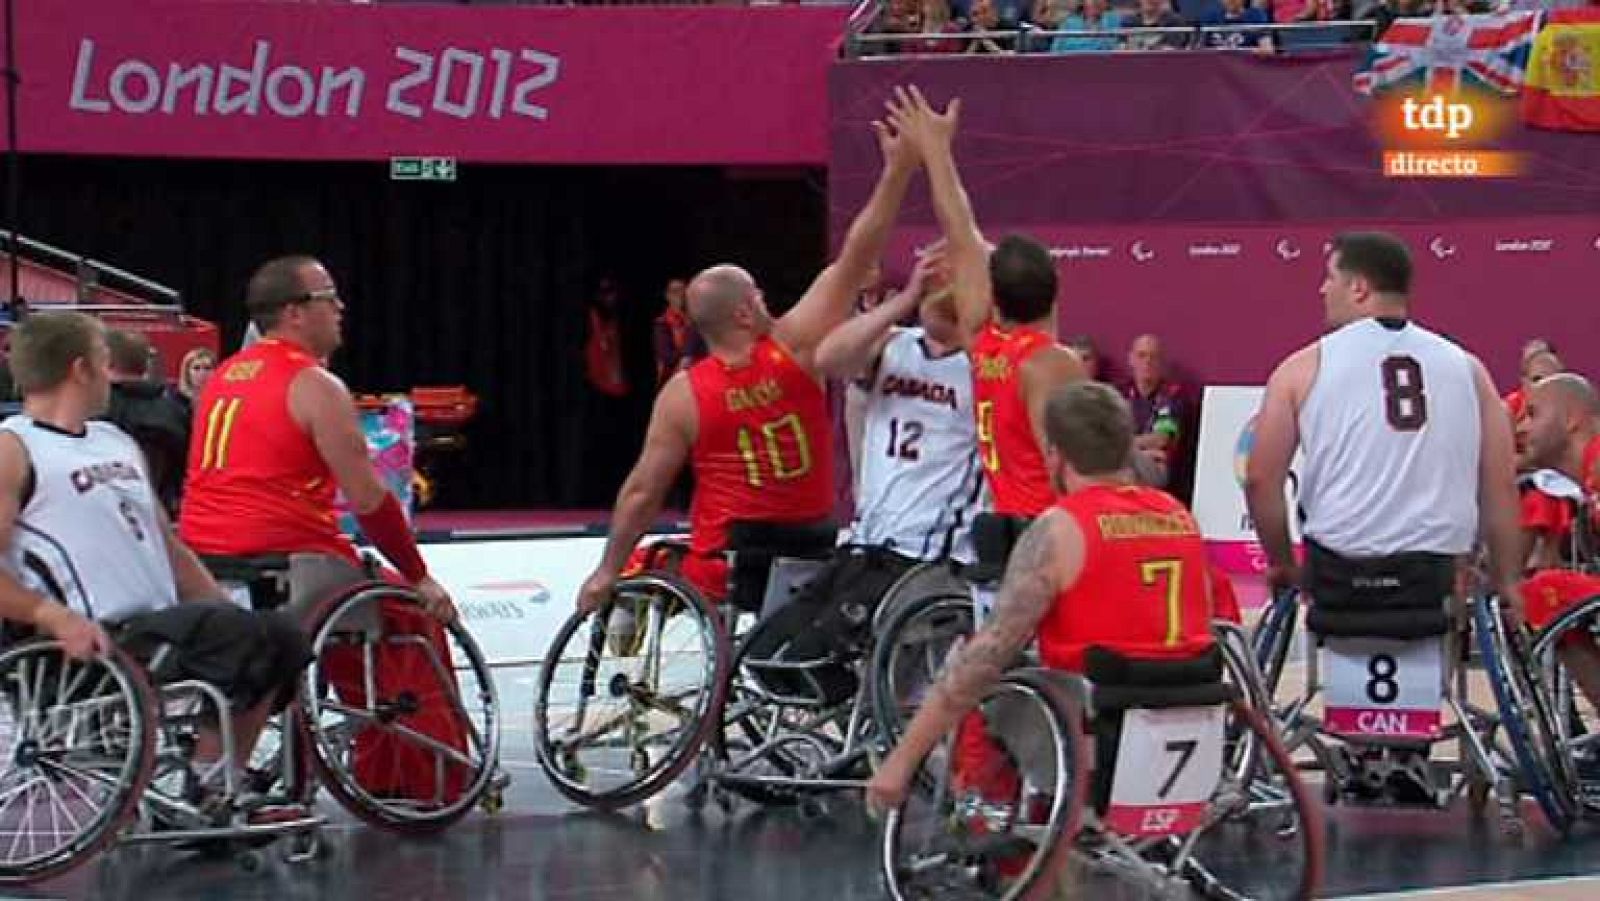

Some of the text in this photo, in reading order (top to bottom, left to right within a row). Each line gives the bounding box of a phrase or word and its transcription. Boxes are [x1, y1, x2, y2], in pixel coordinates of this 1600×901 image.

[69, 38, 560, 119] London 2012
[1381, 355, 1427, 432] 8
[202, 397, 244, 470] 11
[737, 413, 811, 487] 10
[886, 417, 924, 461] 12
[1140, 558, 1184, 648] 7
[1366, 653, 1400, 704] 8
[1357, 710, 1410, 735] CAN
[1157, 740, 1199, 799] 7
